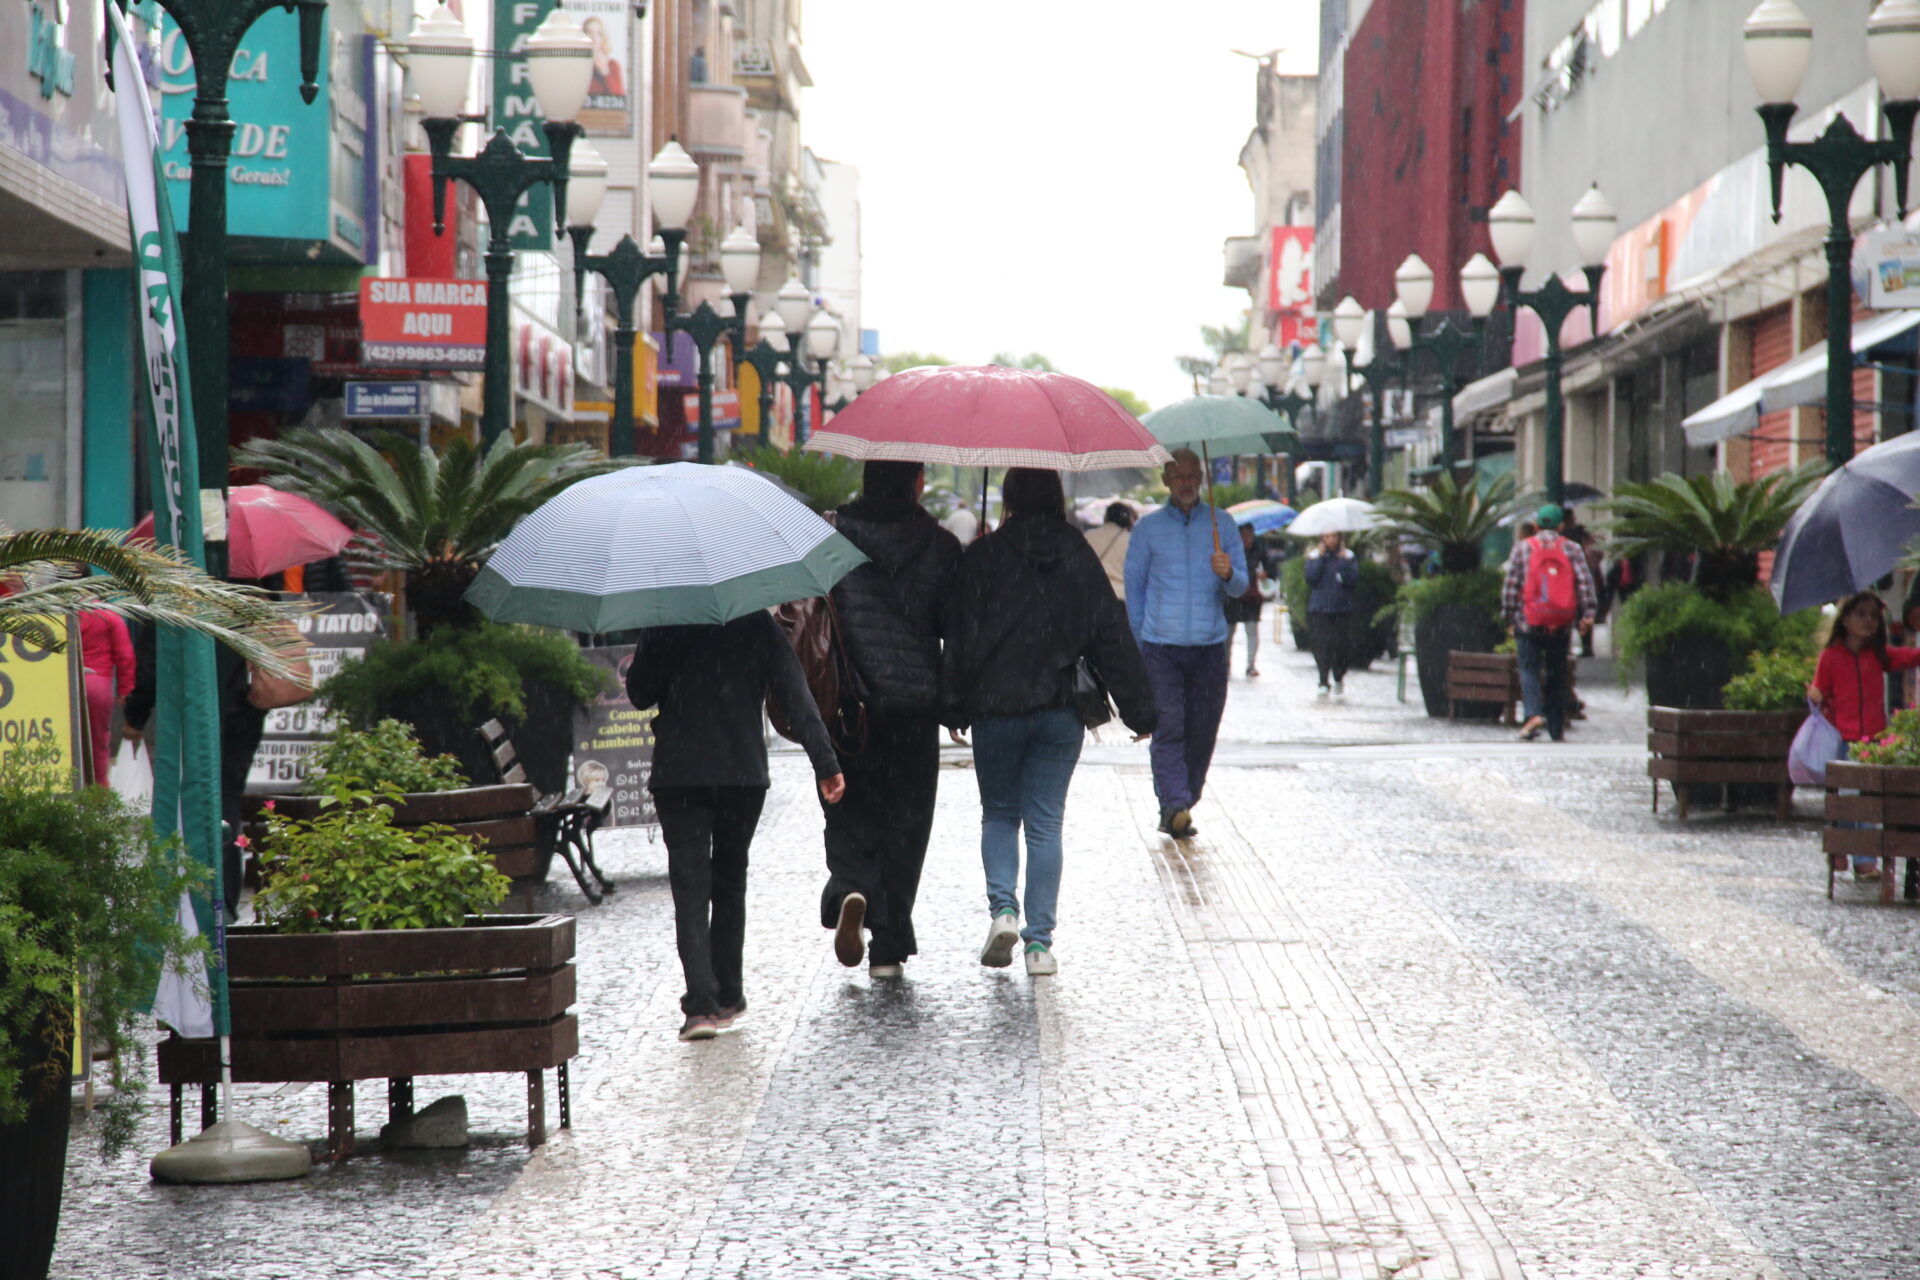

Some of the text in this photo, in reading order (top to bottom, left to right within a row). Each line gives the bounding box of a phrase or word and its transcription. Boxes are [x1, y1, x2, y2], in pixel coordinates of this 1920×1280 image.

[231, 165, 291, 186] Gerais!
[370, 281, 487, 306] SUA MARCA
[403, 312, 452, 336] AQUI
[598, 722, 641, 735] cabelo
[581, 741, 589, 750] e
[593, 735, 644, 749] também
